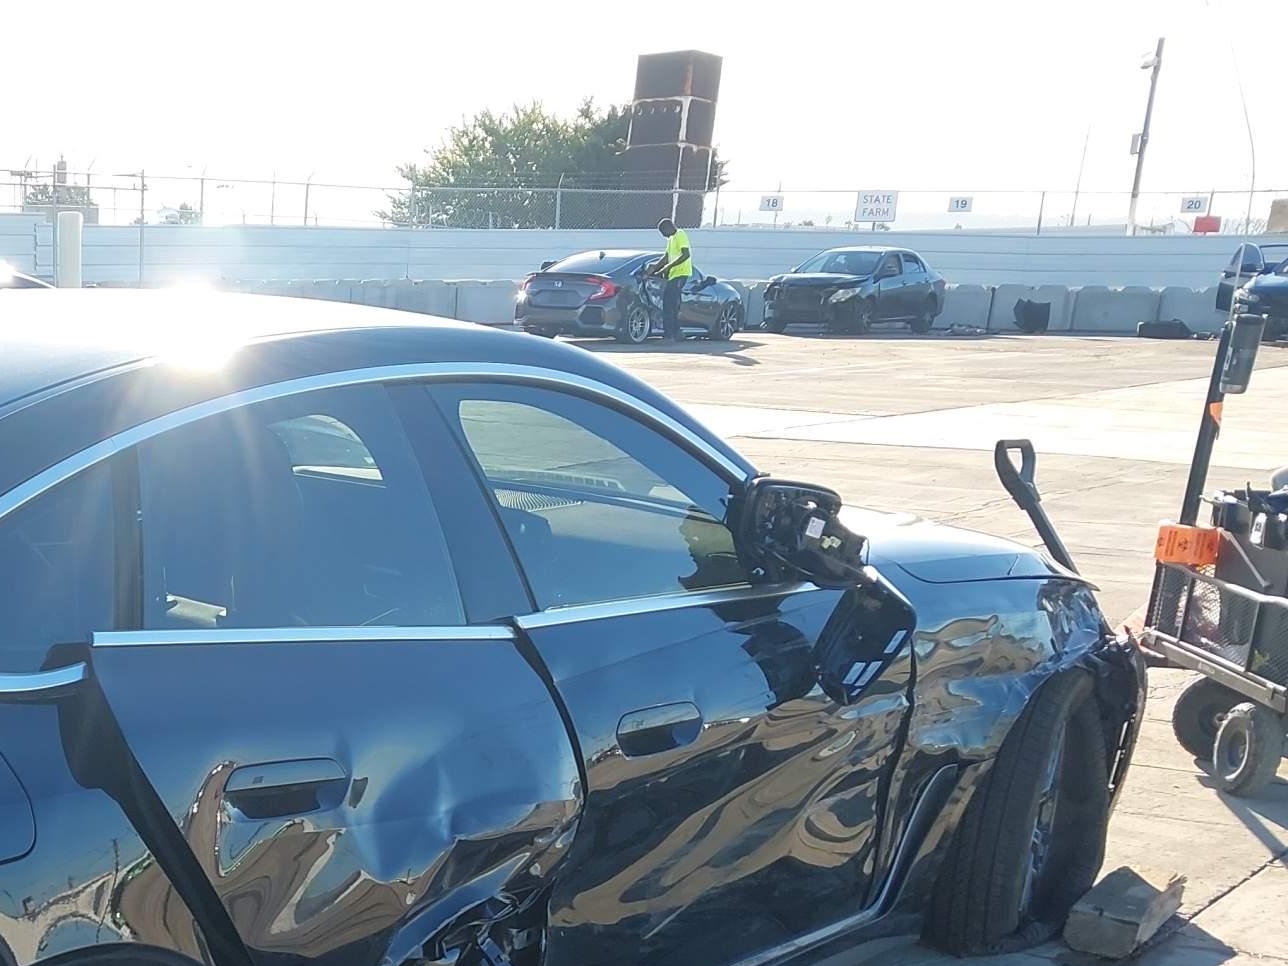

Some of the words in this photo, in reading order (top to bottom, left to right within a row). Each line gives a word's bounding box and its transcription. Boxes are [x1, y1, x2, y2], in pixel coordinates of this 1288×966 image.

[765, 198, 779, 208] 18
[862, 194, 893, 205] STATE
[954, 199, 968, 209] 19
[1187, 200, 1201, 210] 20
[862, 207, 890, 217] FARM
